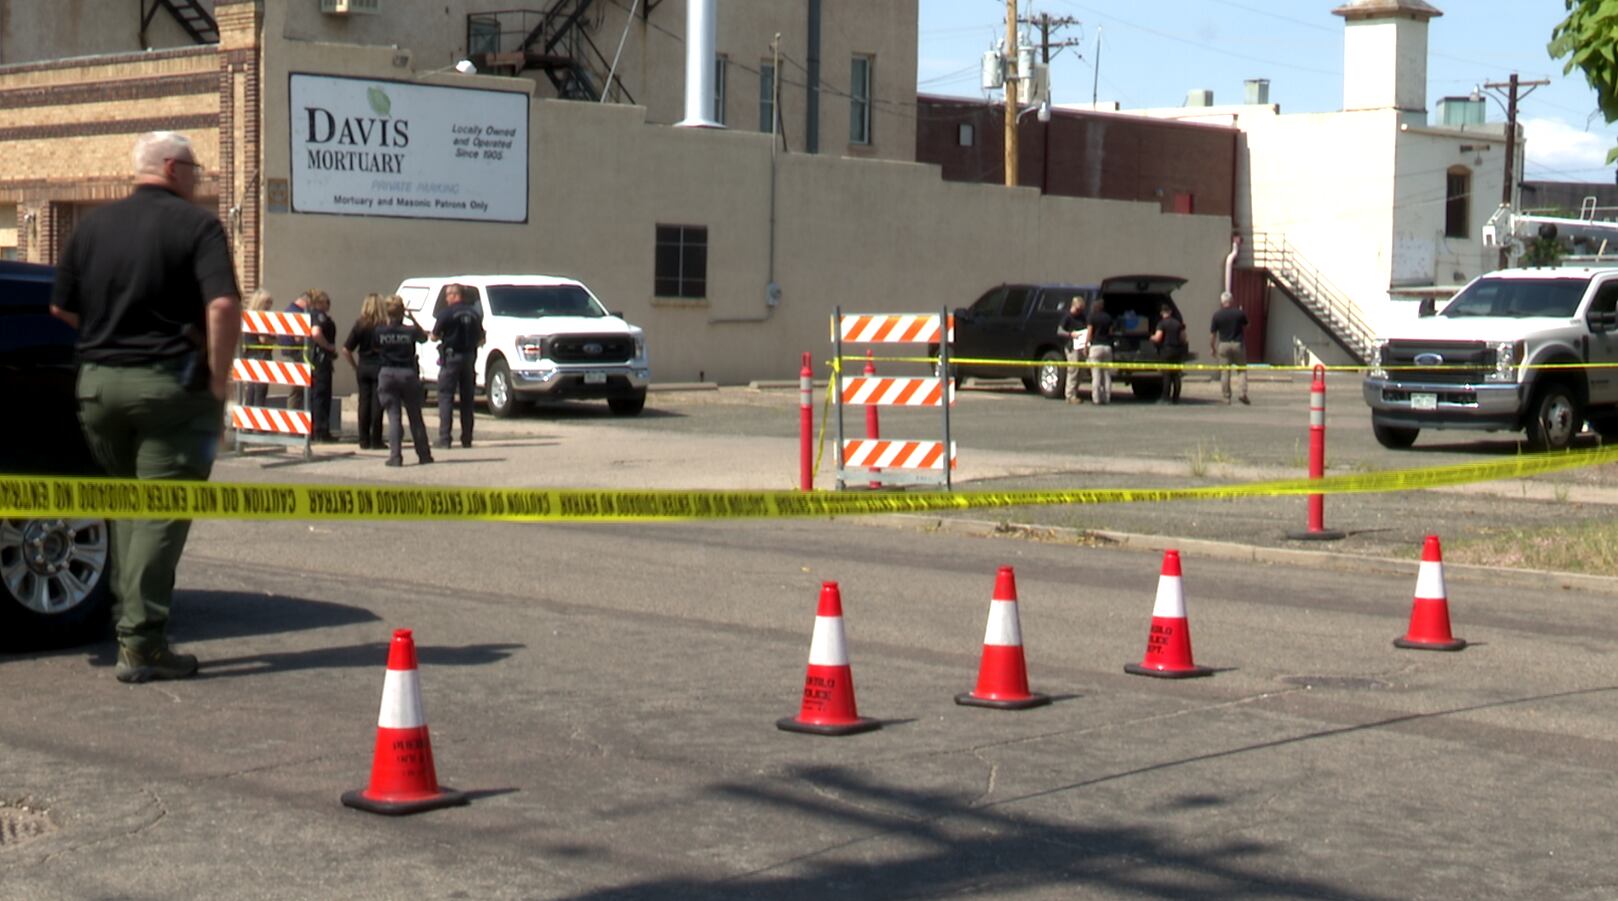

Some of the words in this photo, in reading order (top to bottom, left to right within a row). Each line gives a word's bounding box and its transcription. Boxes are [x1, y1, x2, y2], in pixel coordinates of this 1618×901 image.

[304, 107, 409, 148] DAVIS
[452, 123, 482, 136] Locally
[486, 125, 517, 137] Owned
[453, 138, 470, 146] and
[473, 137, 513, 149] Operated
[456, 148, 479, 159] Since
[307, 149, 405, 174] MORTUARY
[371, 180, 413, 192] PRIVATE
[416, 181, 461, 194] PARKING
[334, 195, 373, 208] Mortuary
[377, 197, 394, 206] and
[396, 197, 431, 208] Masonic
[435, 199, 467, 209] Patrons
[470, 201, 488, 212] Only
